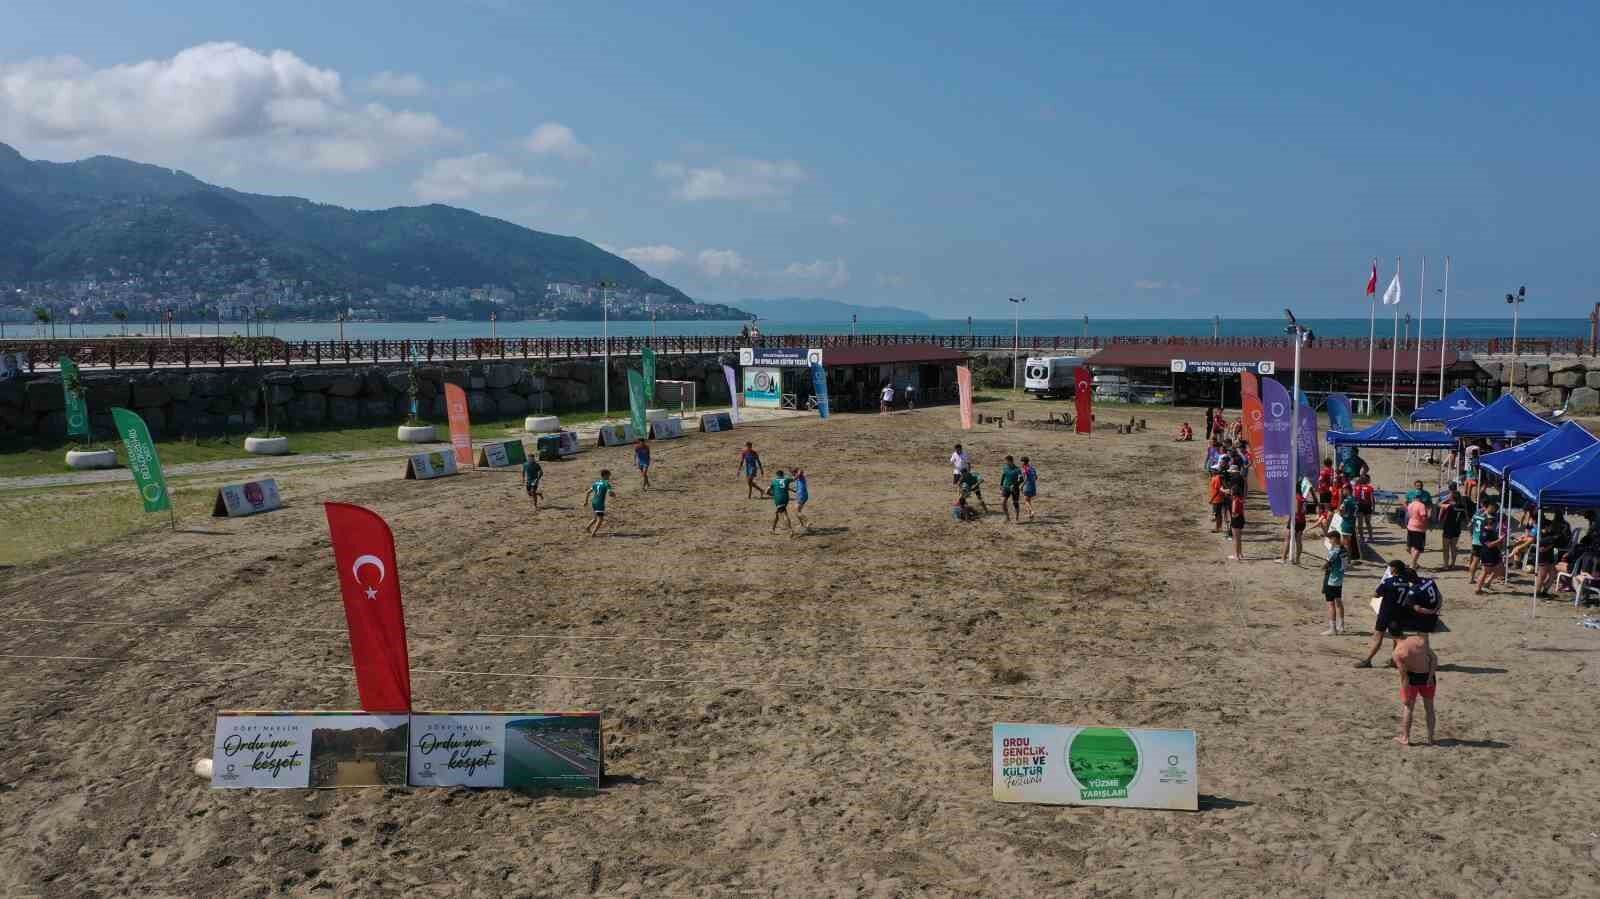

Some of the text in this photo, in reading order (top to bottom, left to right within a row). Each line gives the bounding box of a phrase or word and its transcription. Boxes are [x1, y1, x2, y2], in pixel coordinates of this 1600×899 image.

[1003, 737, 1030, 747] ORDU
[1003, 756, 1046, 766] SPOR VE
[1003, 766, 1043, 776] KÜLTÜR
